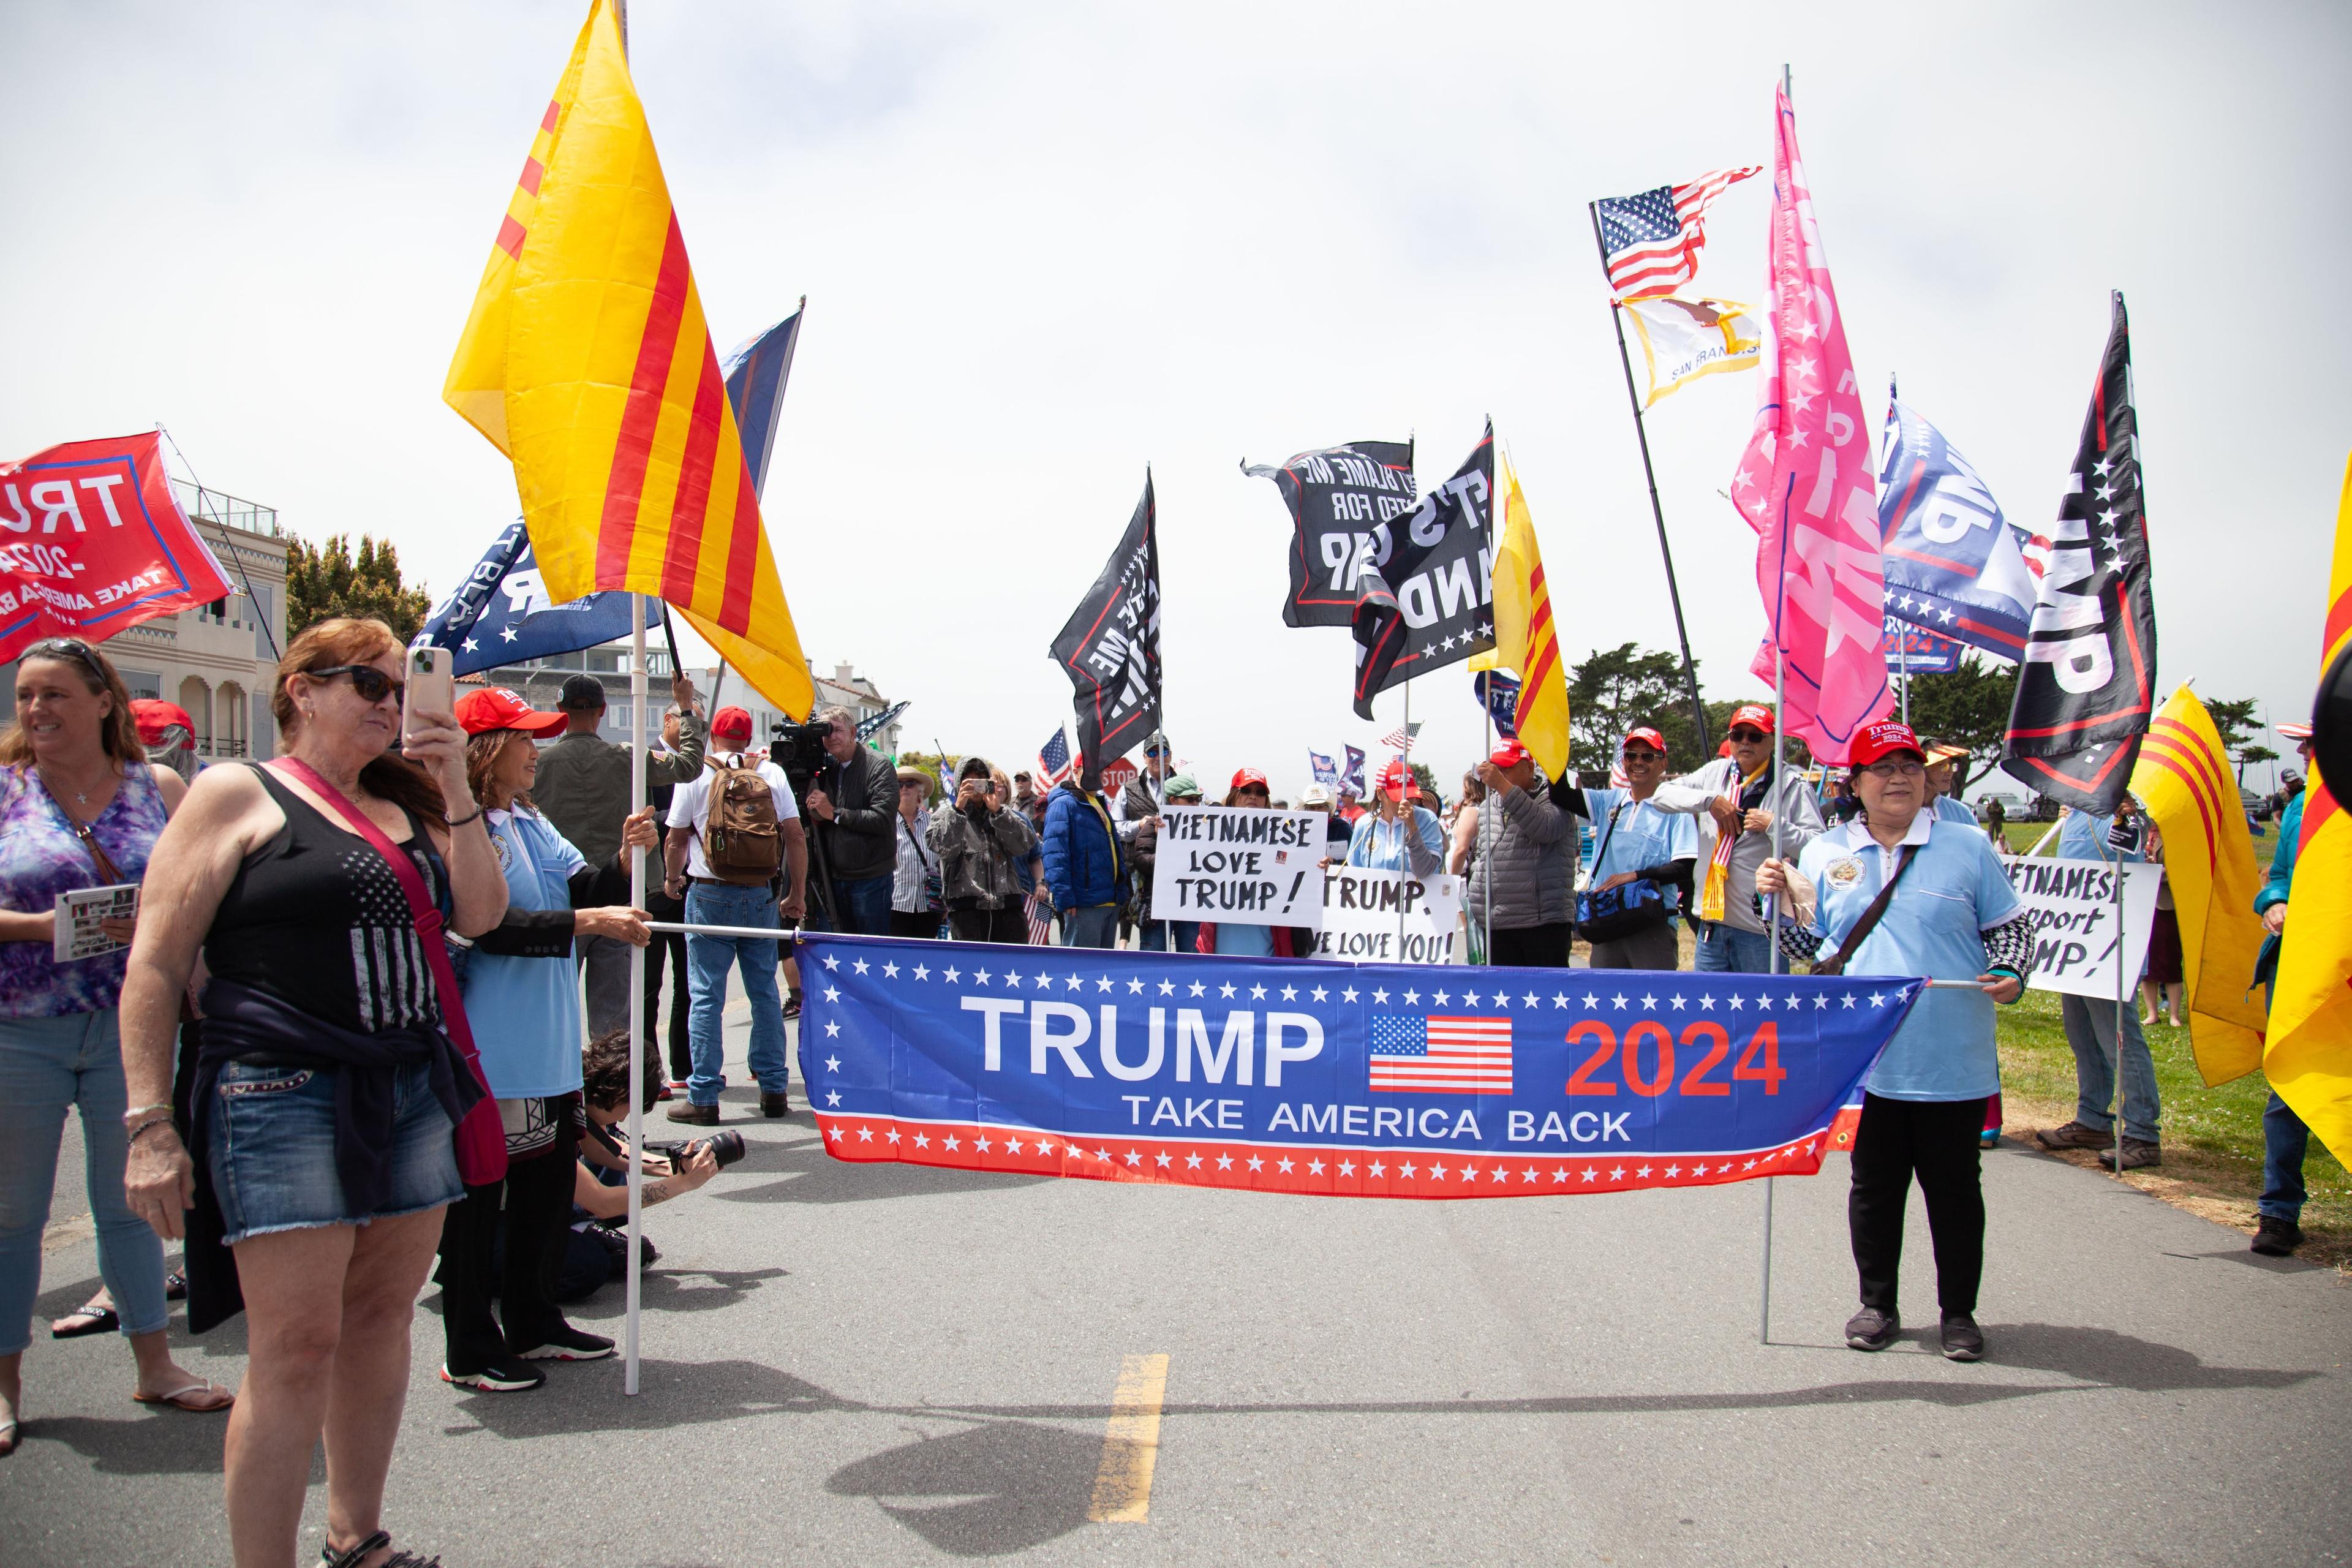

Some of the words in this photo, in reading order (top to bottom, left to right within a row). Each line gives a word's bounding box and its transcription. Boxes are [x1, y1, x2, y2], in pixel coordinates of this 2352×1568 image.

[1672, 361, 1691, 380] SAN
[1696, 345, 1760, 368] FRANS
[1867, 724, 1910, 736] Trump
[1102, 771, 1136, 787] STOP
[1189, 851, 1262, 874] LOVE
[2003, 862, 2132, 903] ETNAMESE
[2027, 907, 2106, 935] pport
[1338, 932, 1392, 959] LOVE
[961, 996, 1324, 1087] TRUMP
[1566, 1020, 1787, 1097] 2024
[1122, 1096, 1245, 1129] TAKE
[1268, 1102, 1483, 1140] AMERICA
[1507, 1110, 1631, 1142] BACK
